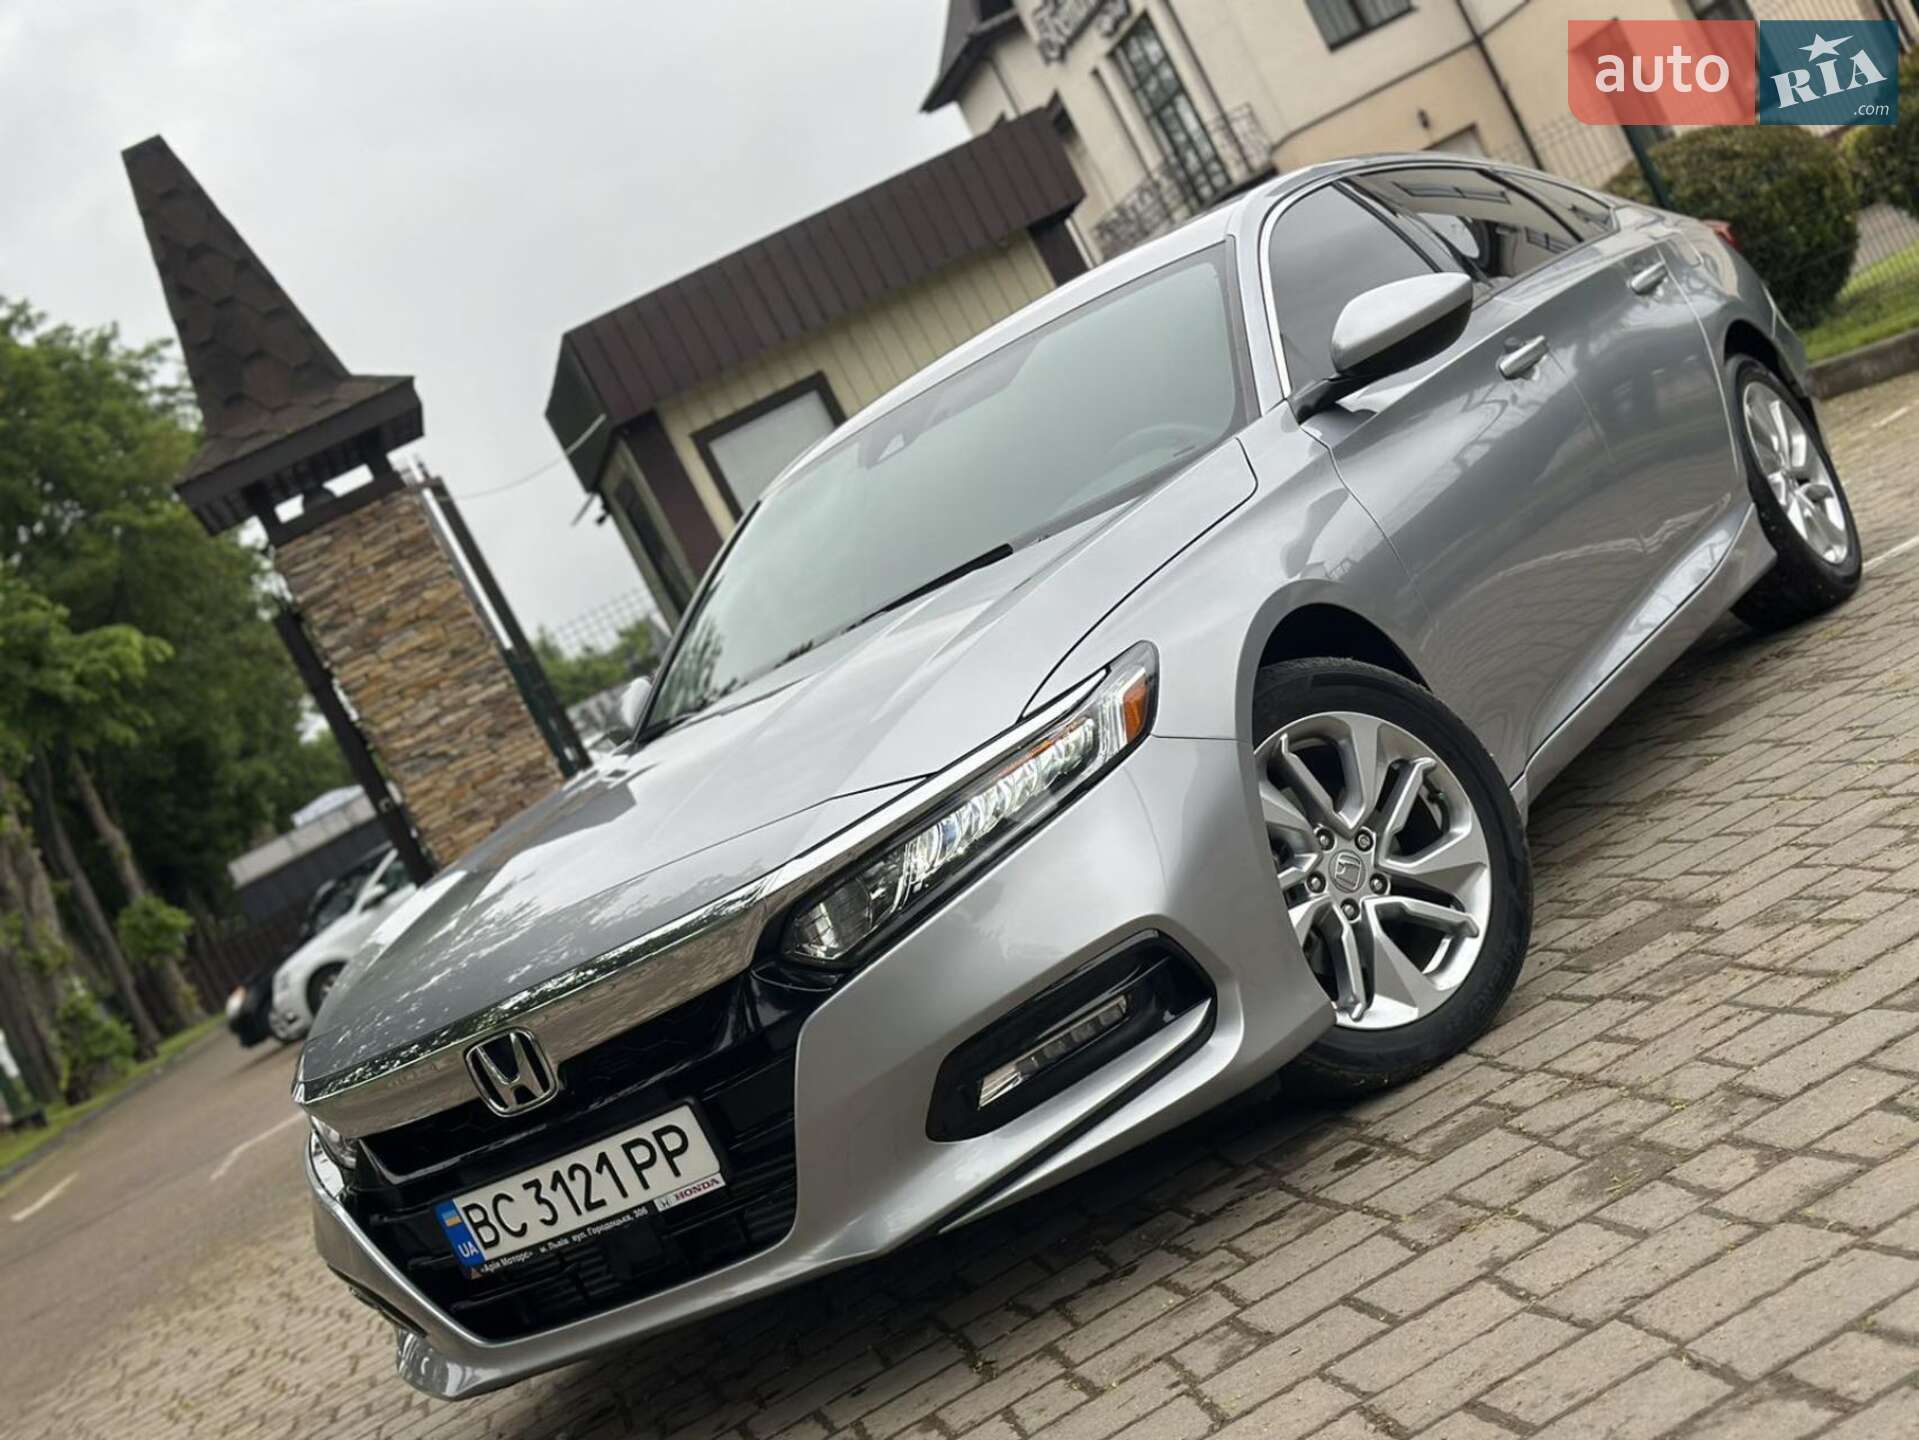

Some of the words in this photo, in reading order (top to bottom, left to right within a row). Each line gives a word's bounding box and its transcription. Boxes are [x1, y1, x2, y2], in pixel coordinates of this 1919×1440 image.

[462, 1193, 528, 1250] BC
[522, 1151, 629, 1226] 3121
[621, 1124, 690, 1190] PP
[674, 1178, 720, 1201] HONDA
[458, 1240, 478, 1259] UA
